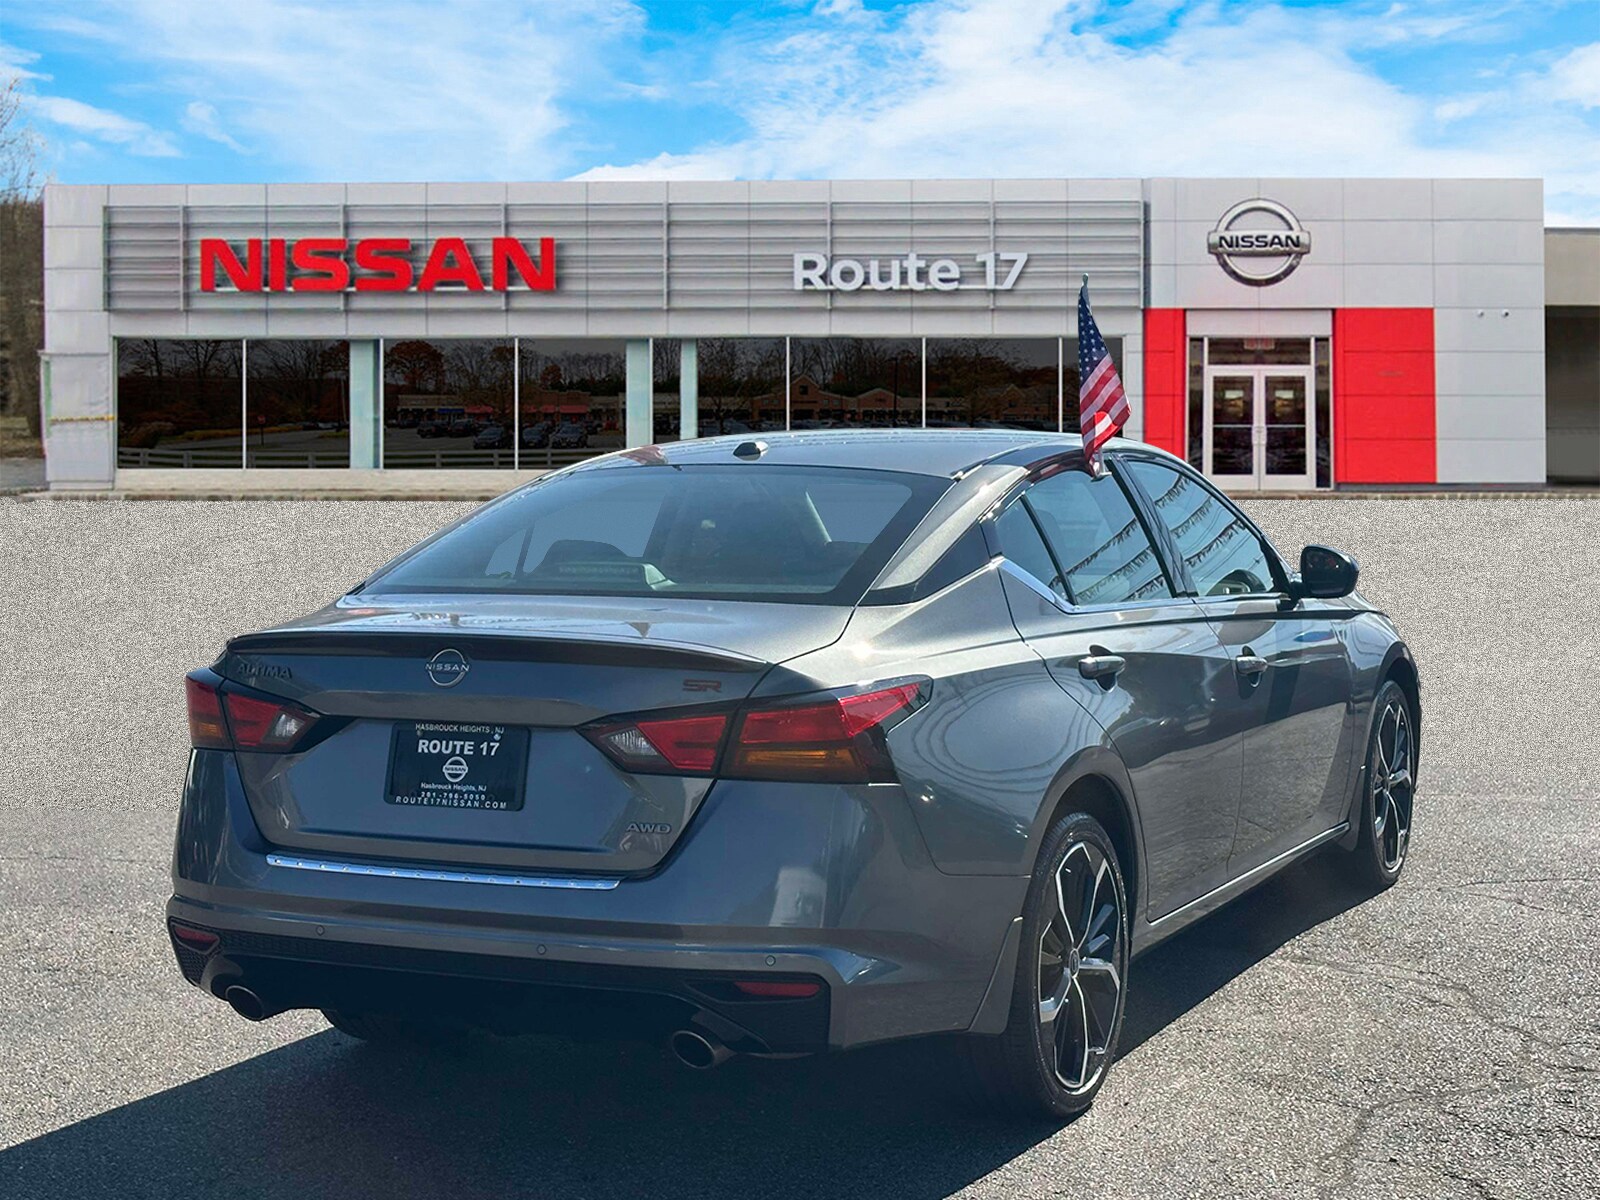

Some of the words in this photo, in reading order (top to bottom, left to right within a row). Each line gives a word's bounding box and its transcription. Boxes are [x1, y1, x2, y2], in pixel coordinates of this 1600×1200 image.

[1218, 234, 1300, 249] NISSAN
[200, 237, 556, 292] NISSAN
[793, 251, 960, 291] Route
[975, 252, 1028, 290] 17
[236, 663, 293, 680] ALTIMA
[425, 663, 470, 673] NISSAN
[682, 679, 722, 692] SR
[415, 723, 458, 732] HASBROUCK
[417, 739, 474, 755] ROUTE
[480, 742, 500, 756] 17
[420, 782, 452, 790] Hasbrouck
[395, 796, 507, 809] ROUTE17NISSAN.COM
[626, 822, 672, 834] AWD
